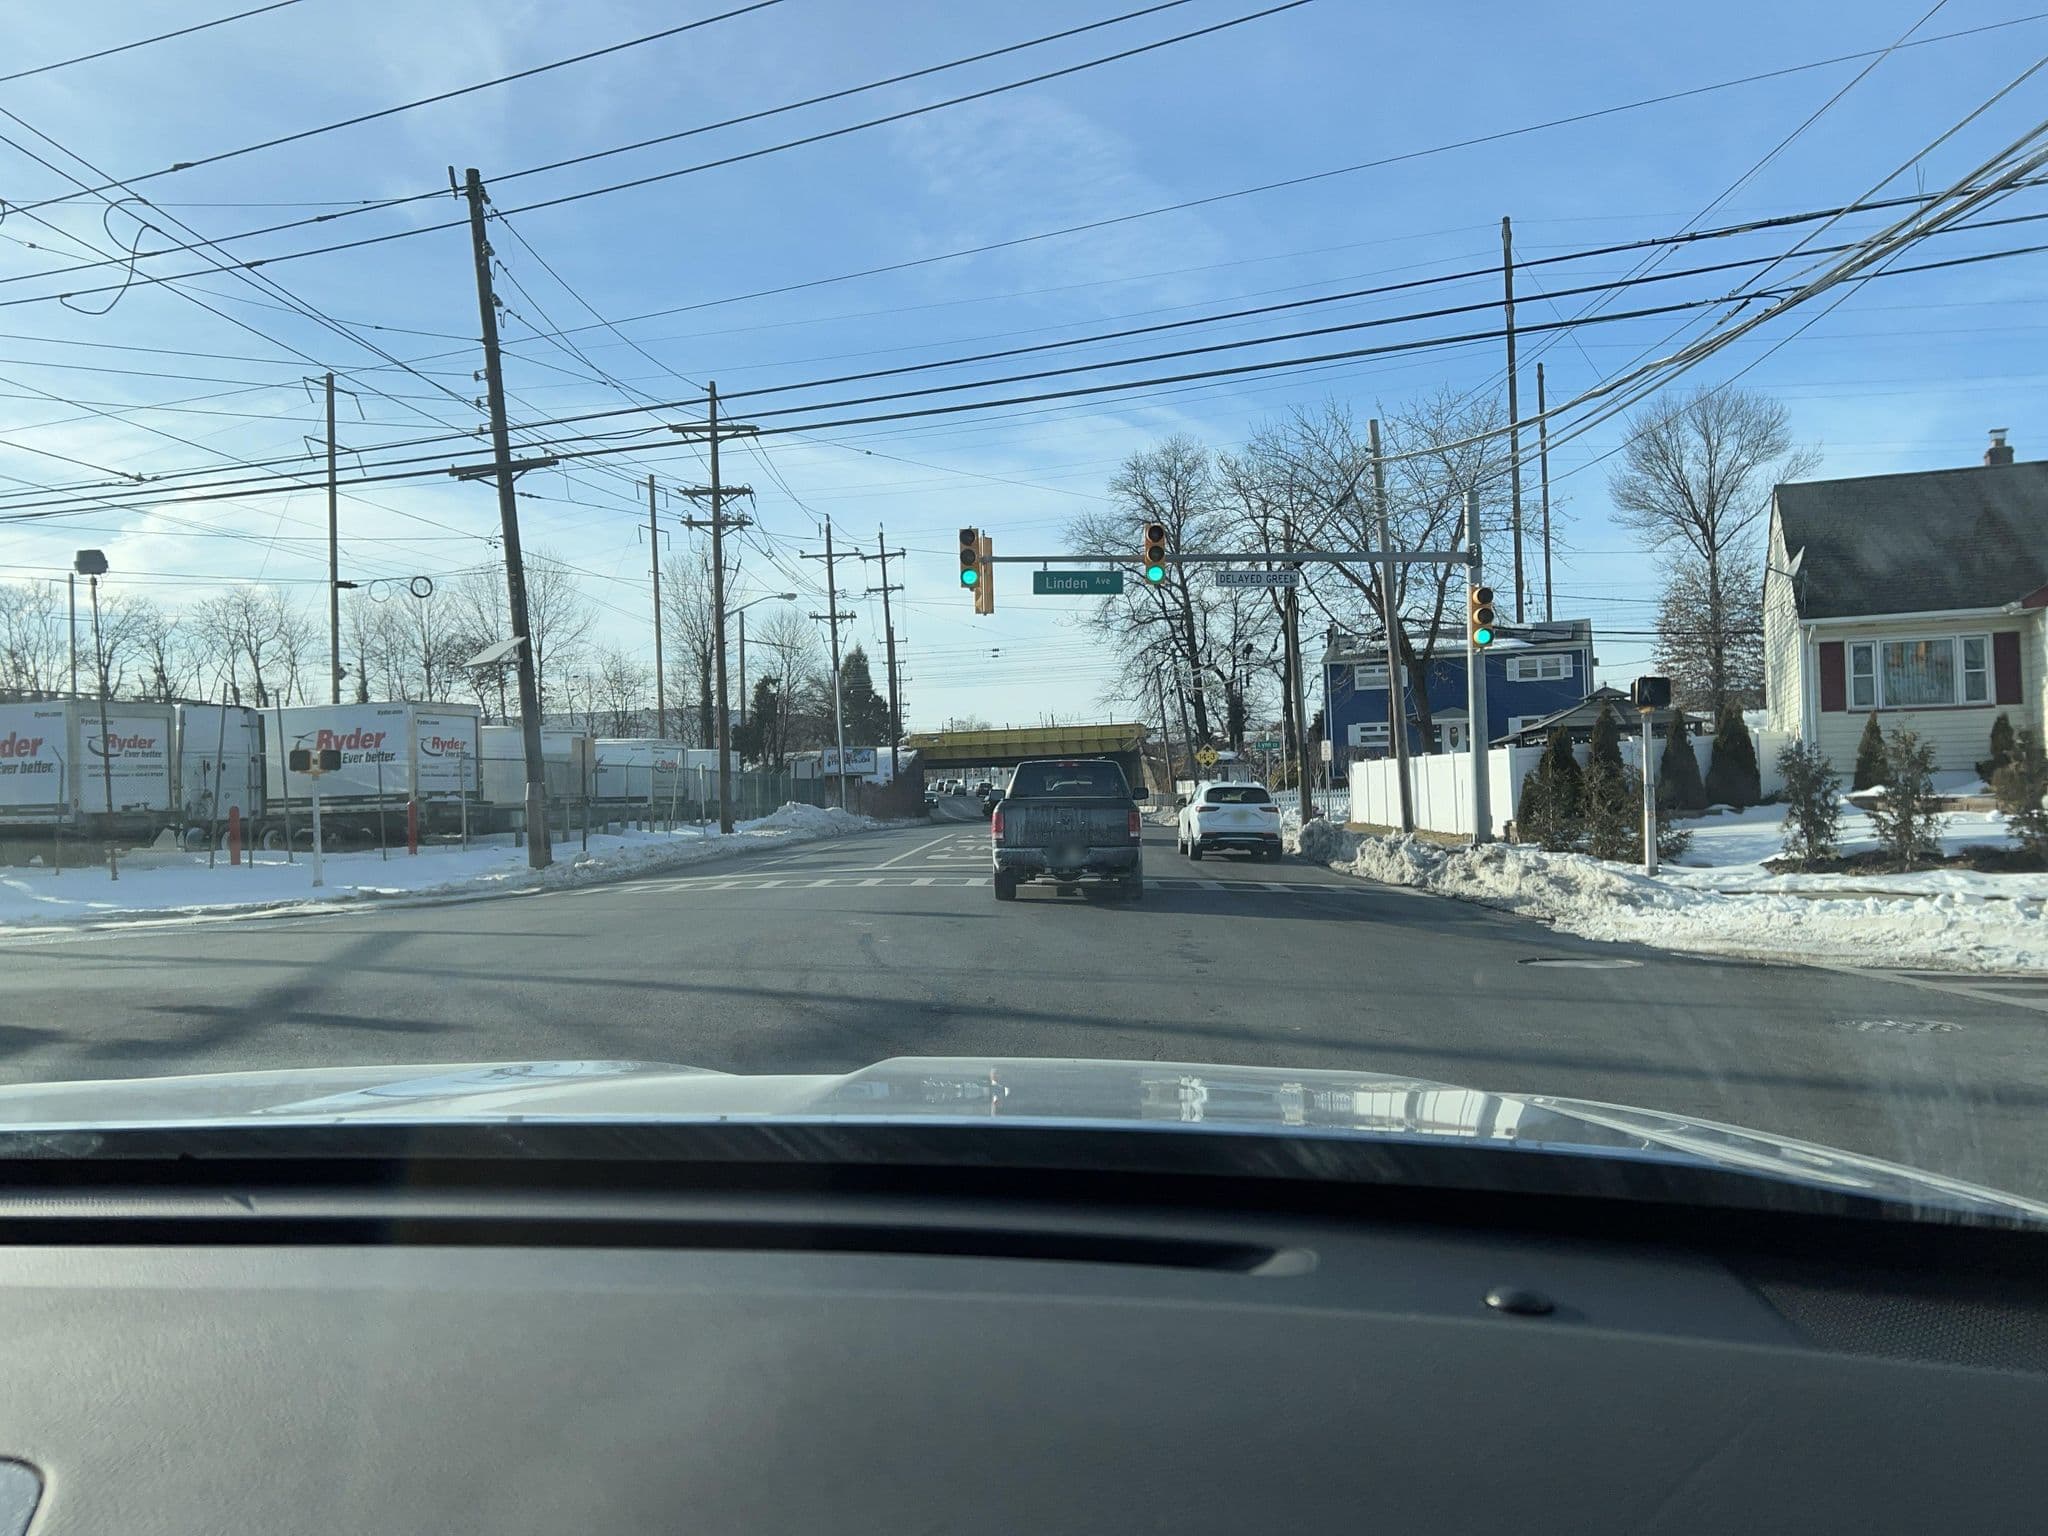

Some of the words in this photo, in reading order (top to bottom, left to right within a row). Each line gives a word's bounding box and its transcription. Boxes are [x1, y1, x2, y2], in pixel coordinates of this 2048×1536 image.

[1046, 577, 1088, 589] Linden
[1095, 577, 1111, 585] Ave
[1219, 574, 1262, 583] DELAYED
[1266, 574, 1297, 584] GREEN
[0, 731, 43, 758] der
[105, 733, 157, 751] Ryder
[316, 728, 386, 750] Ryder
[431, 736, 468, 753] Ryder
[124, 750, 141, 758] Ever
[342, 752, 363, 764] Ever
